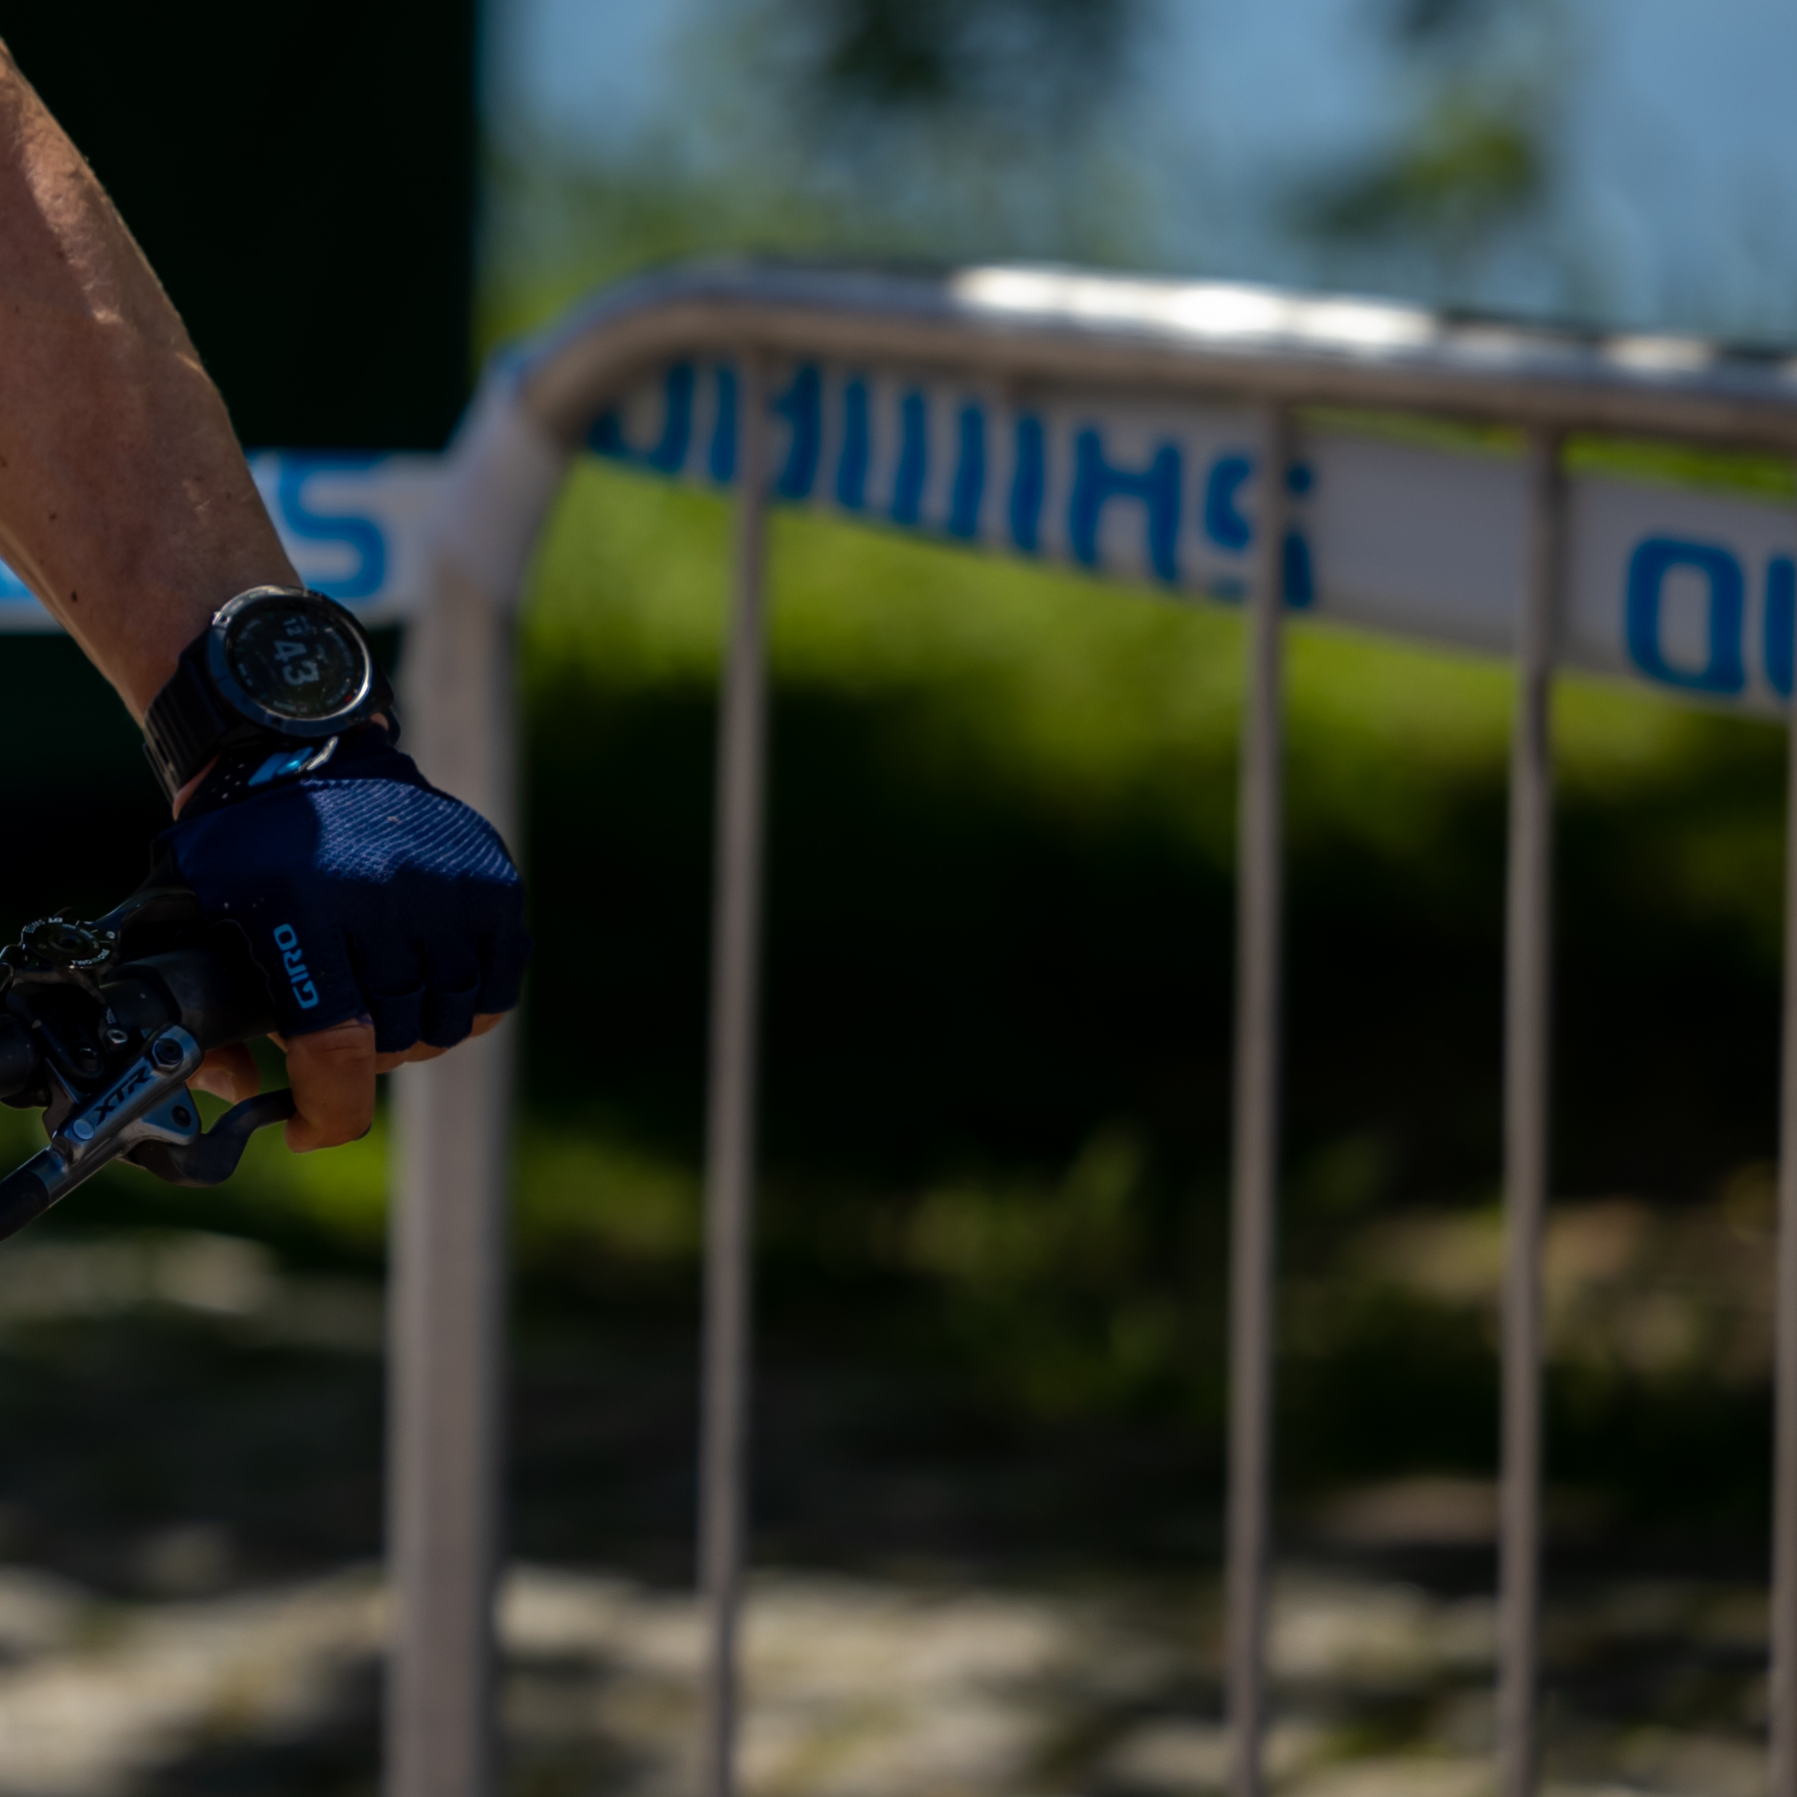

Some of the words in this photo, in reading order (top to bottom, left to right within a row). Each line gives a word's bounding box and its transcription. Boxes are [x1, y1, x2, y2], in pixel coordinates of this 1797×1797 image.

[272, 639, 322, 687] 43
[272, 922, 321, 1010] GIRO
[92, 1066, 151, 1126] XTR
